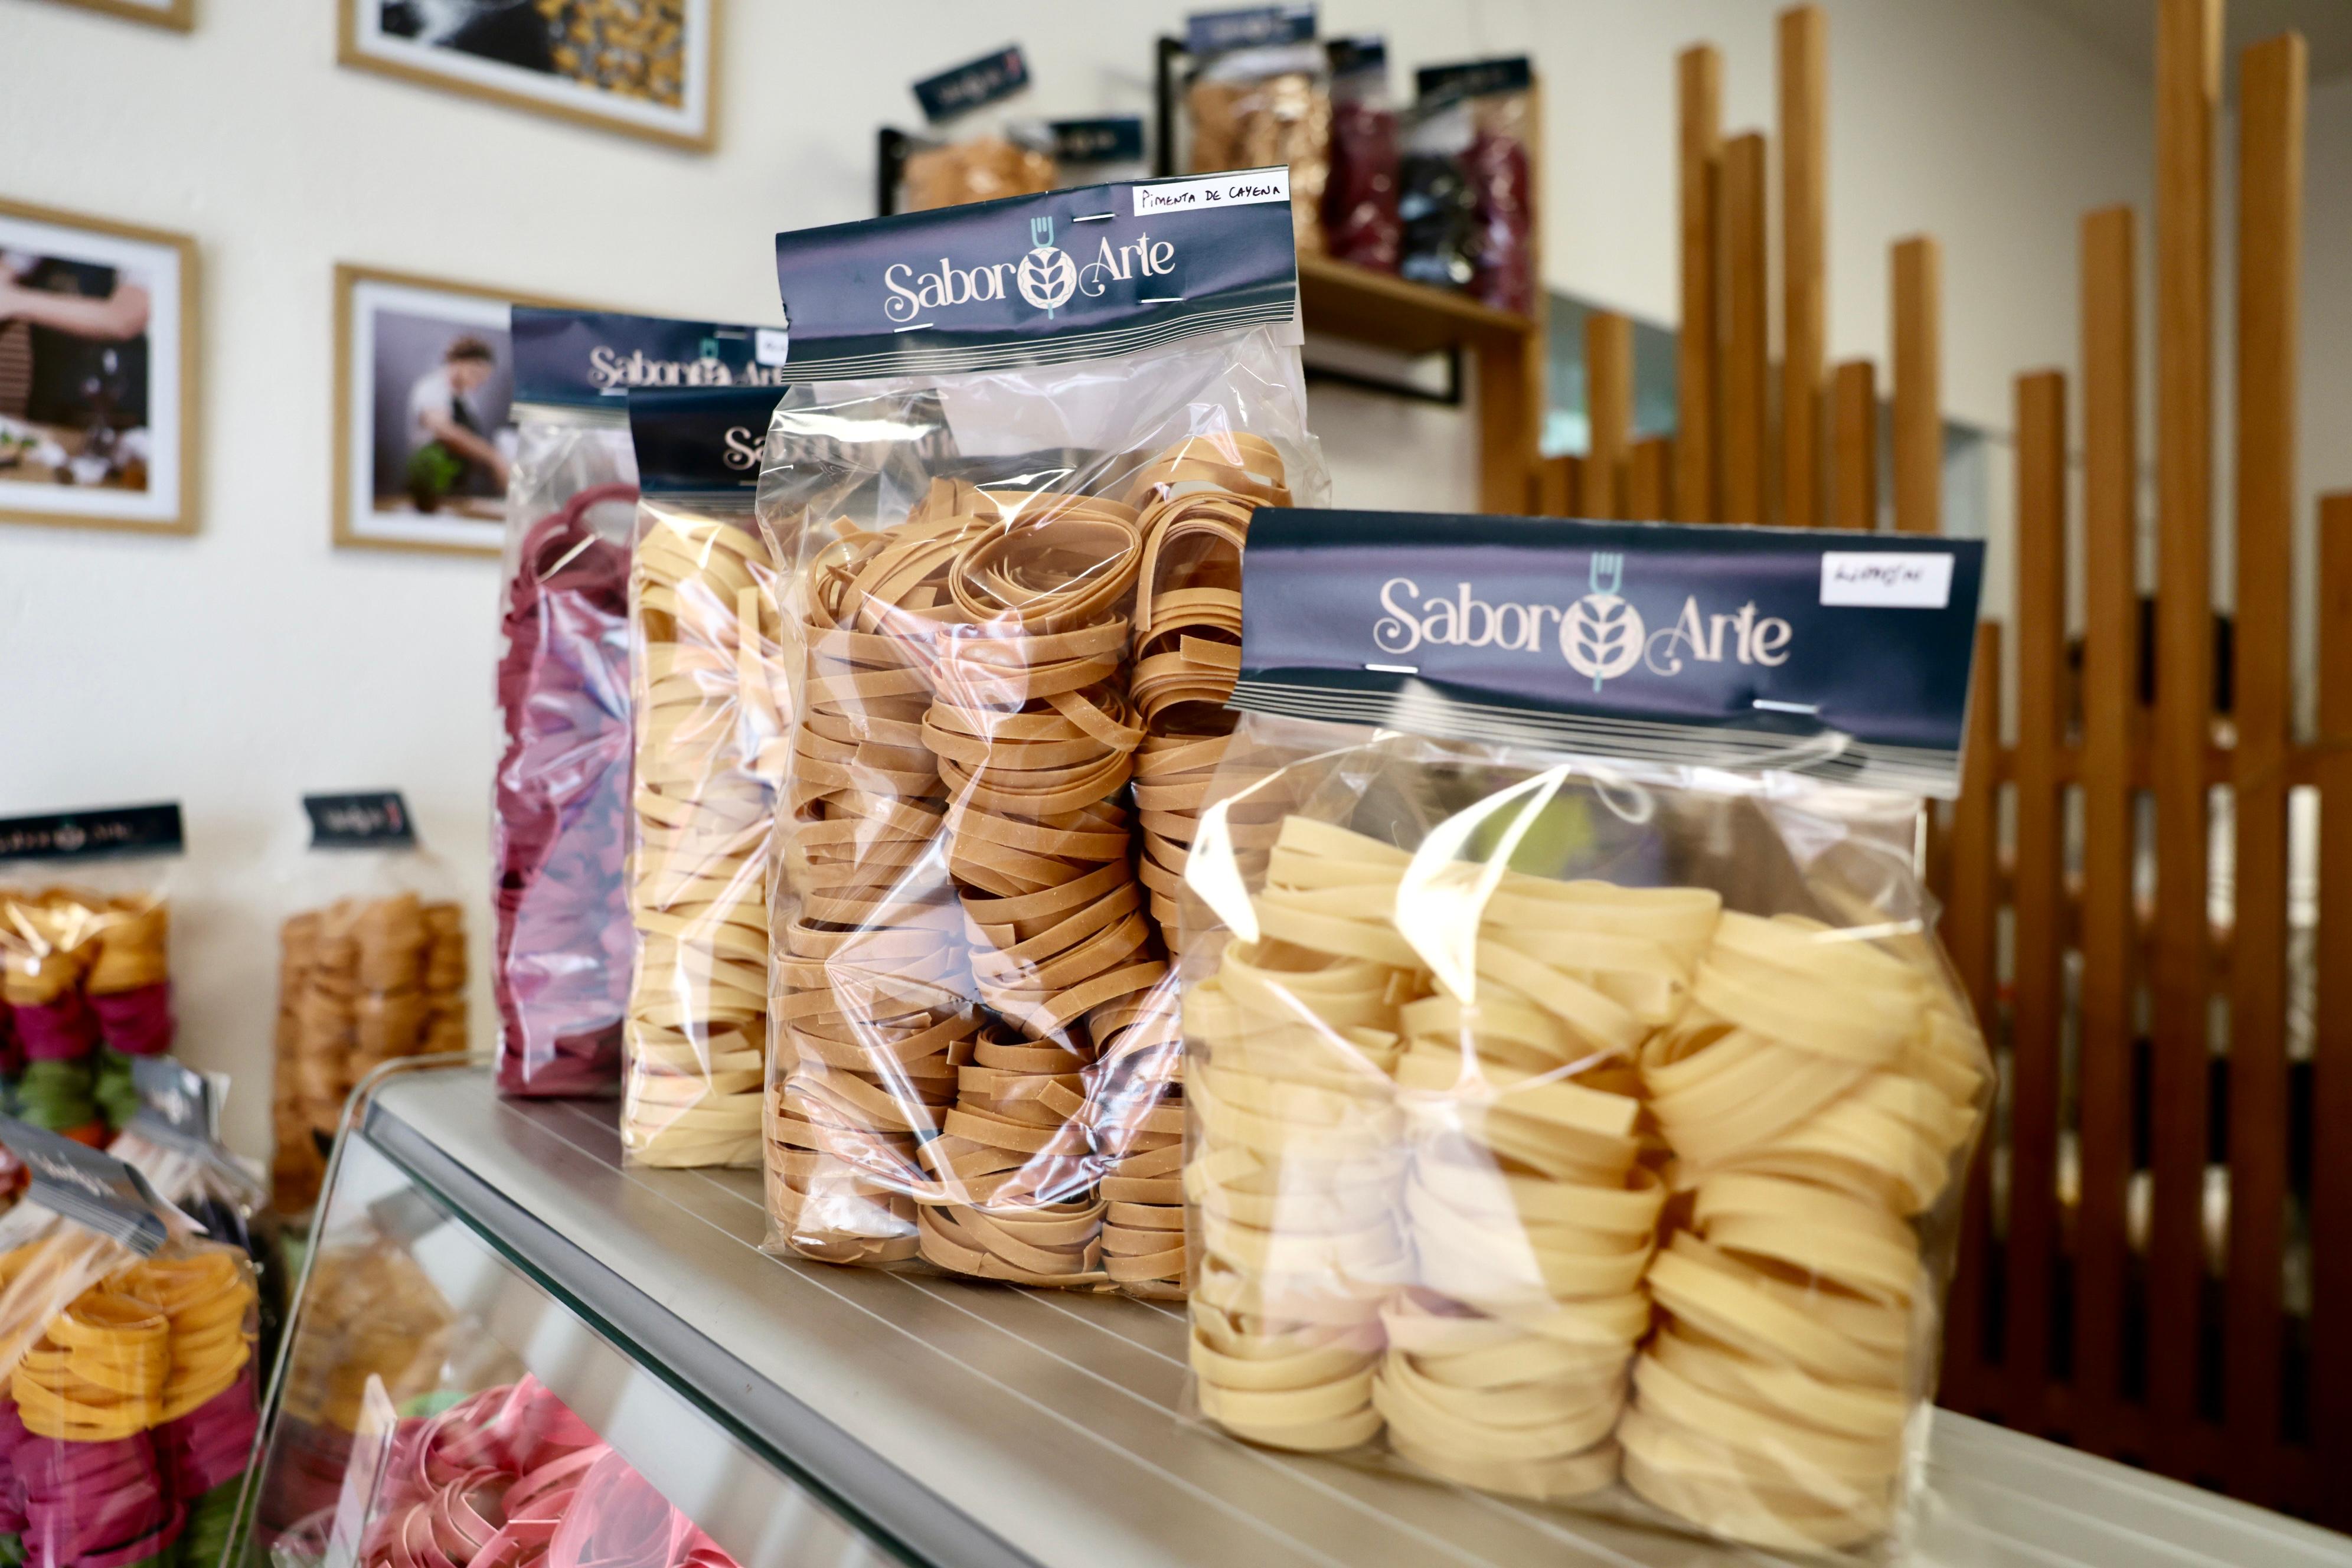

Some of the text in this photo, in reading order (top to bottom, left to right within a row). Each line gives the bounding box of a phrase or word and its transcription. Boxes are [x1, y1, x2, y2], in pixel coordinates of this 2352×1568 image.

[1205, 190, 1221, 201] DE
[1229, 185, 1280, 198] CAYENA
[884, 231, 1175, 322] Sabor Arte
[1373, 577, 1792, 678] Sabor Arte
